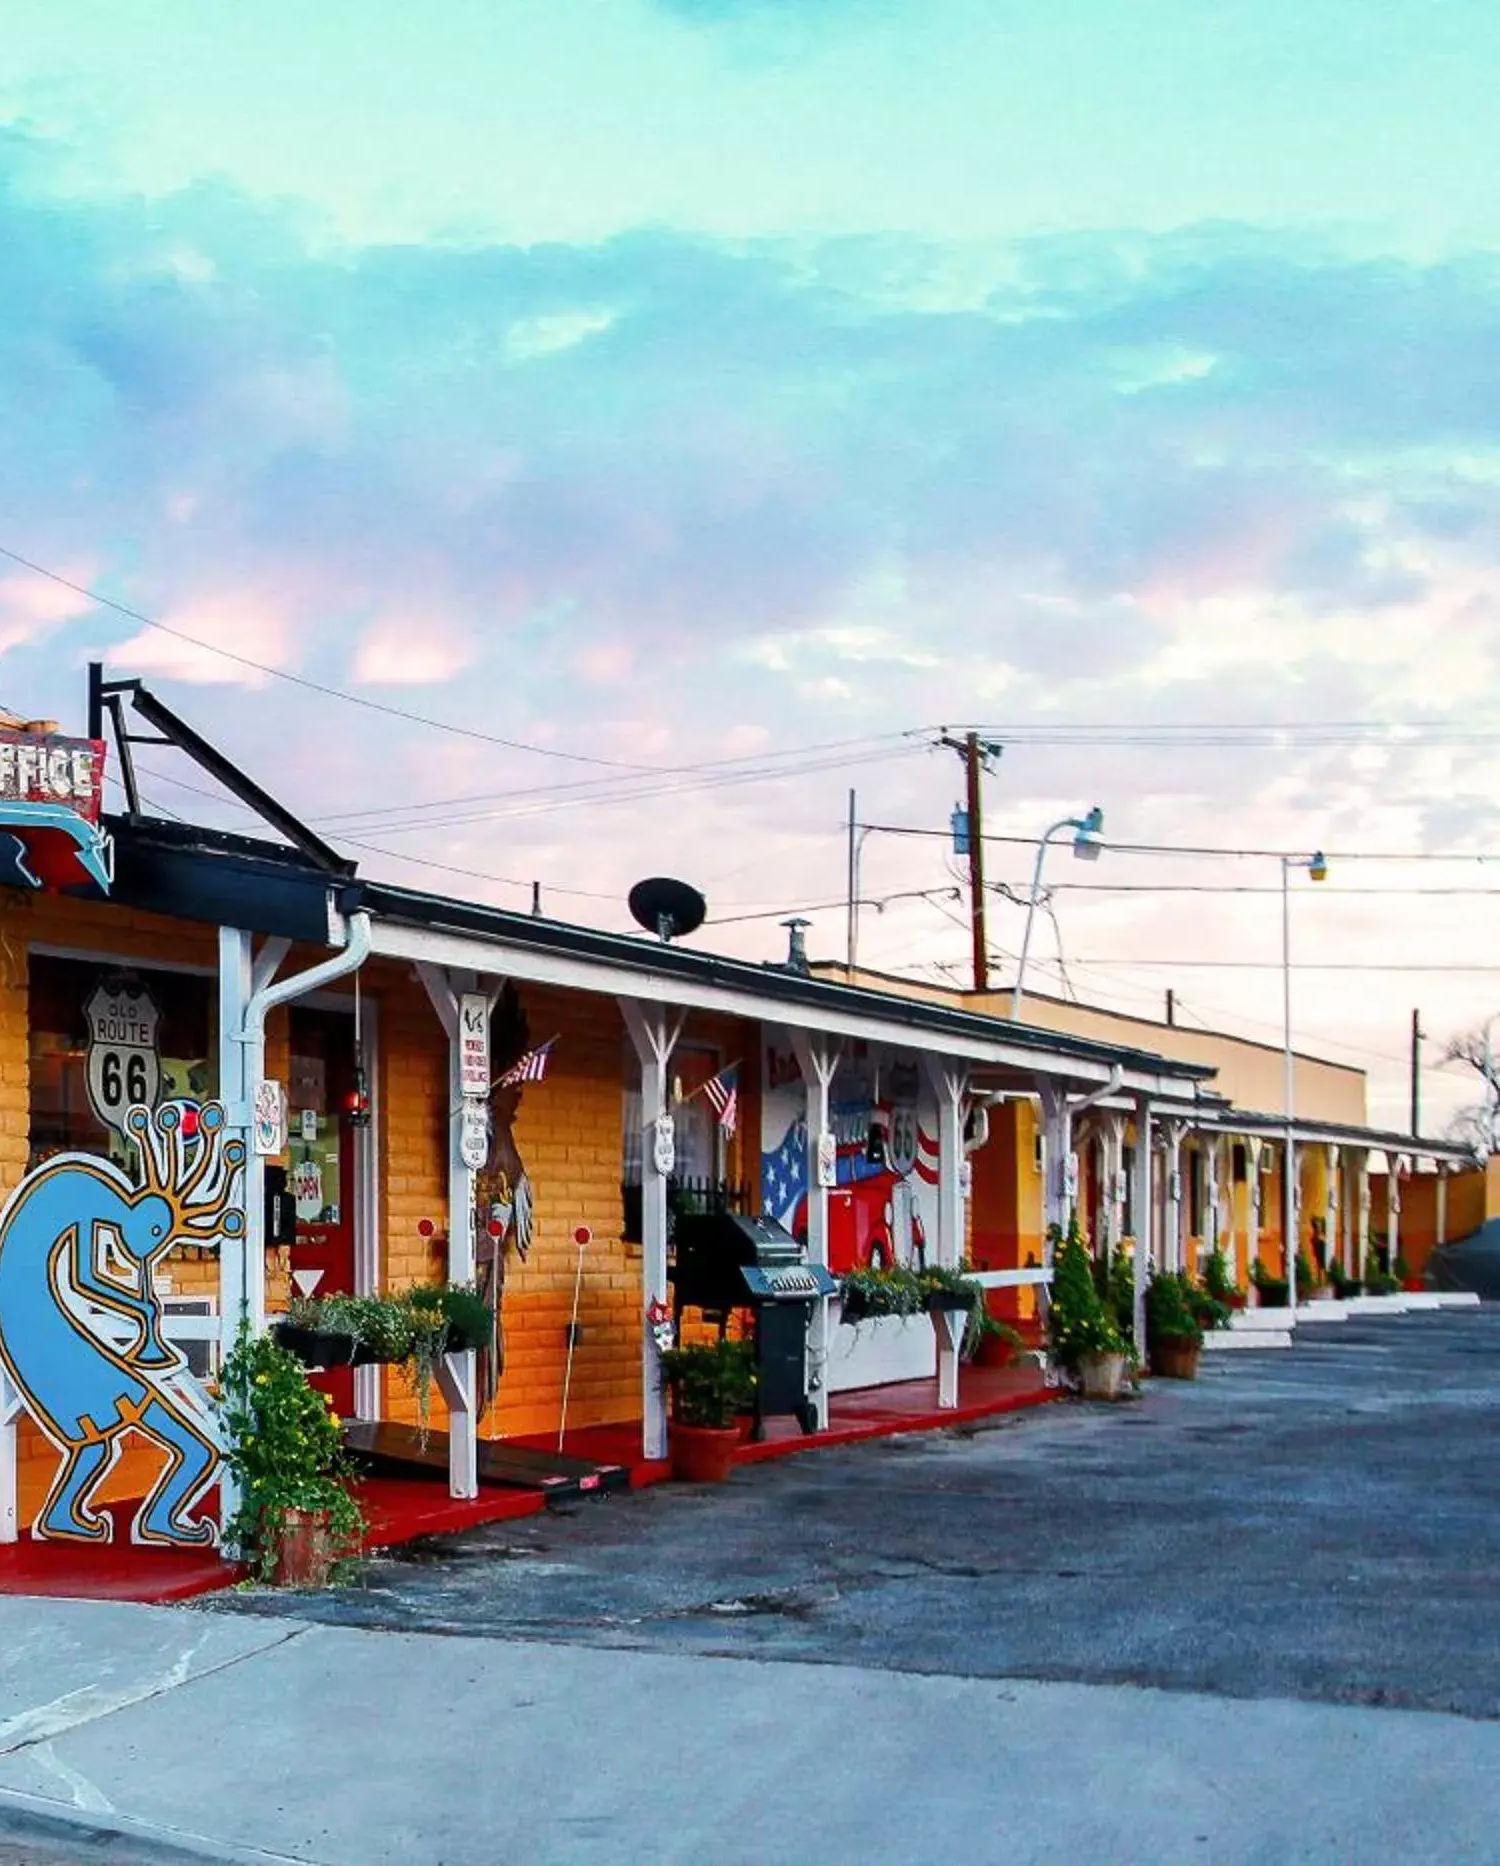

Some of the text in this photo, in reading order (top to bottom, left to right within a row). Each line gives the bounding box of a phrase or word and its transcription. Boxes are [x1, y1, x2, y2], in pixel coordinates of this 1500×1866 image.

[108, 1004, 137, 1018] OLD
[97, 1019, 149, 1042] ROUTE
[102, 1052, 147, 1106] 66
